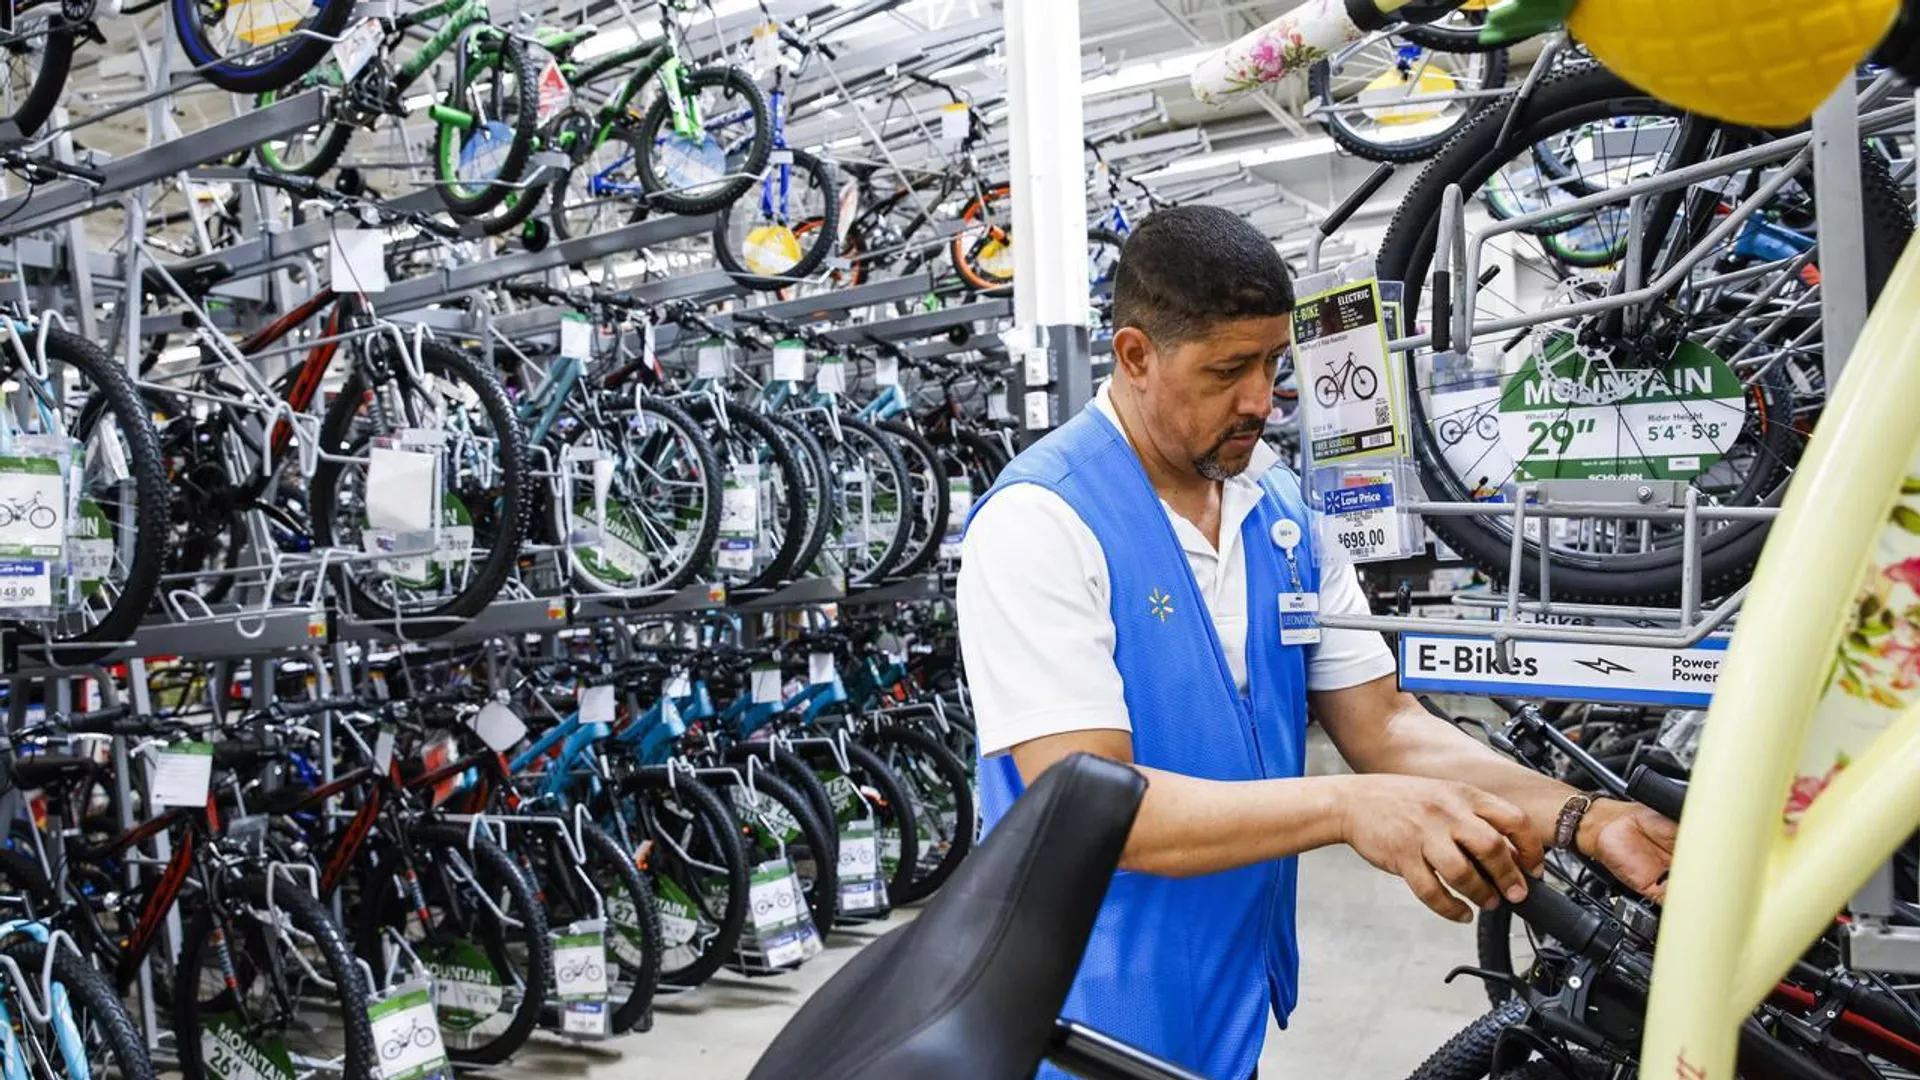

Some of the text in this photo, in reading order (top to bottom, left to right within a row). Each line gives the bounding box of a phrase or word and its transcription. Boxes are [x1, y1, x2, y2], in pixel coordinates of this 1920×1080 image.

[1337, 288, 1370, 306] ELECTRIC
[1648, 412, 1704, 423] Rider Height
[1527, 418, 1596, 456] 29"
[1341, 496, 1359, 506] Low
[1359, 492, 1381, 504] Price
[1338, 528, 1385, 549] $698.00
[1418, 644, 1539, 677] E-Bikes
[1672, 655, 1719, 669] Power
[1672, 668, 1718, 683] Power
